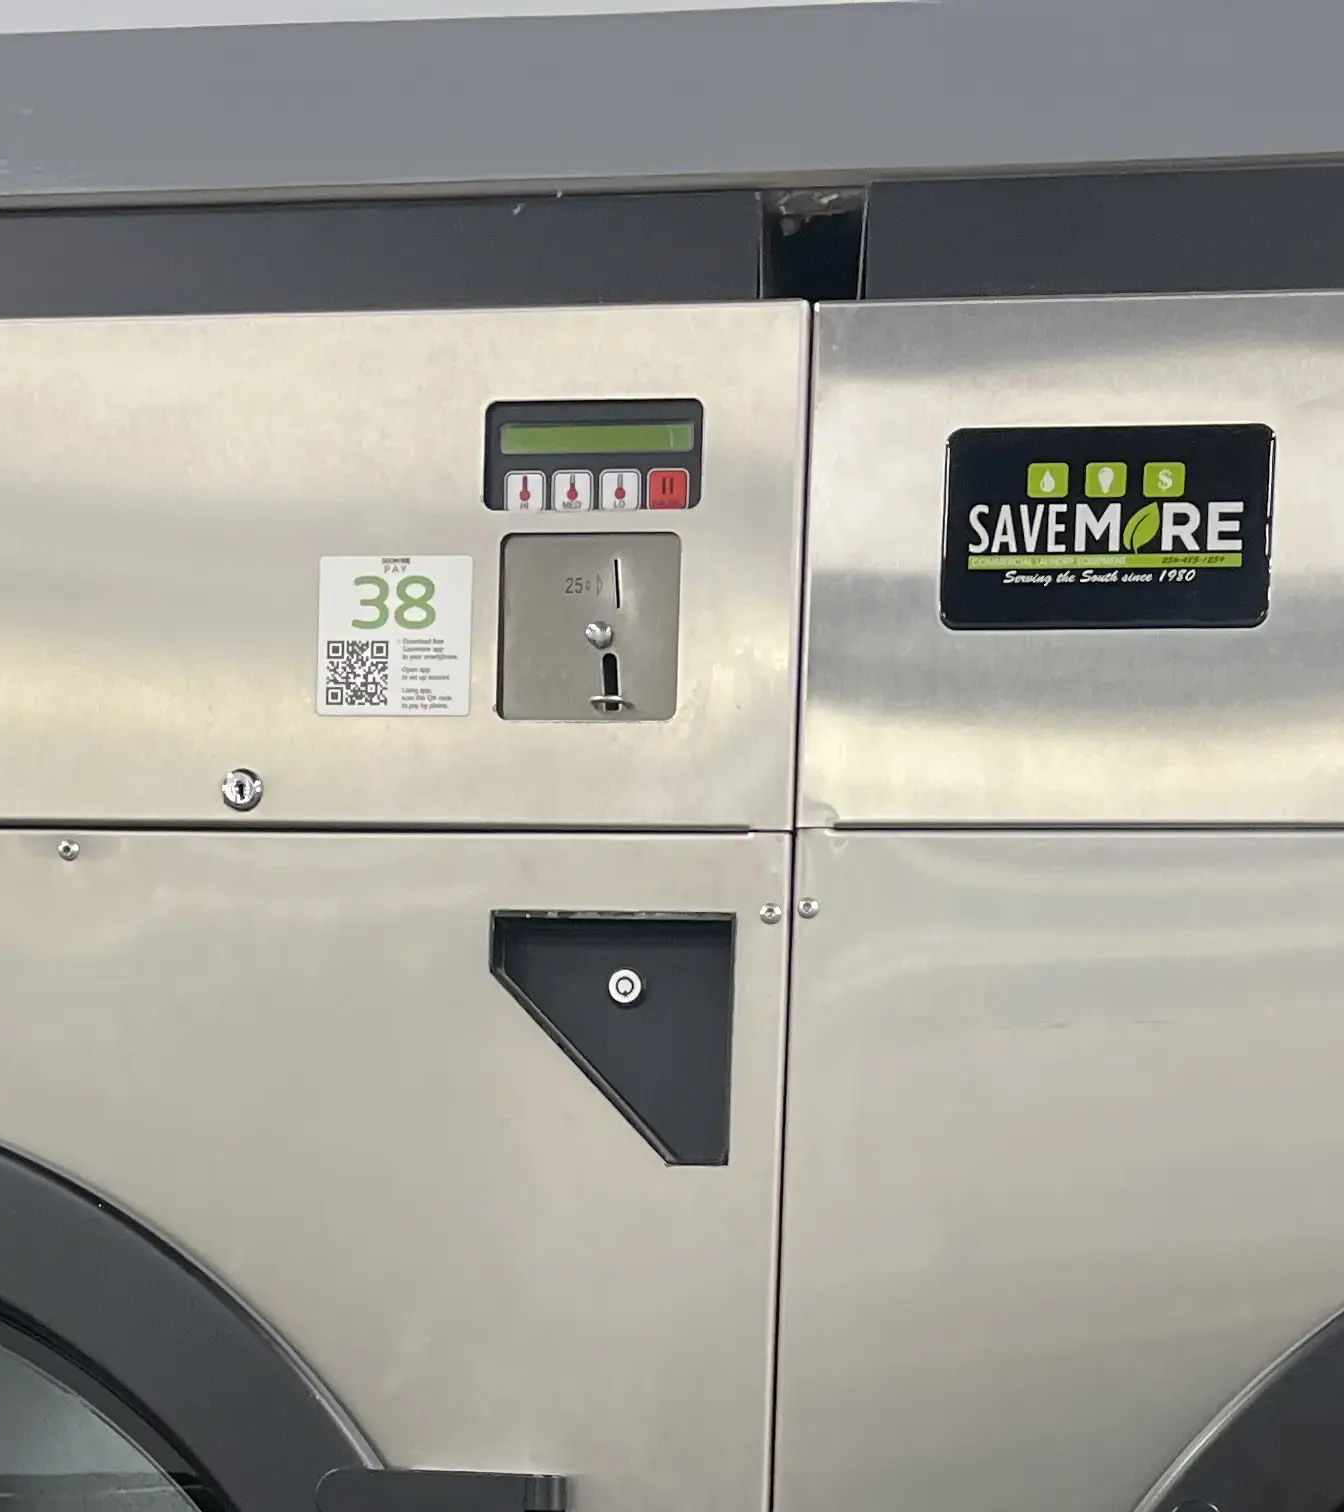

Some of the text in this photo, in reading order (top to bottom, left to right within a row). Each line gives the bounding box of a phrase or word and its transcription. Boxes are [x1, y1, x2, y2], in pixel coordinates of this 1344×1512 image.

[383, 564, 407, 574] PAY
[1003, 569, 1197, 587] Serving the South since 1980
[351, 575, 436, 630] 38
